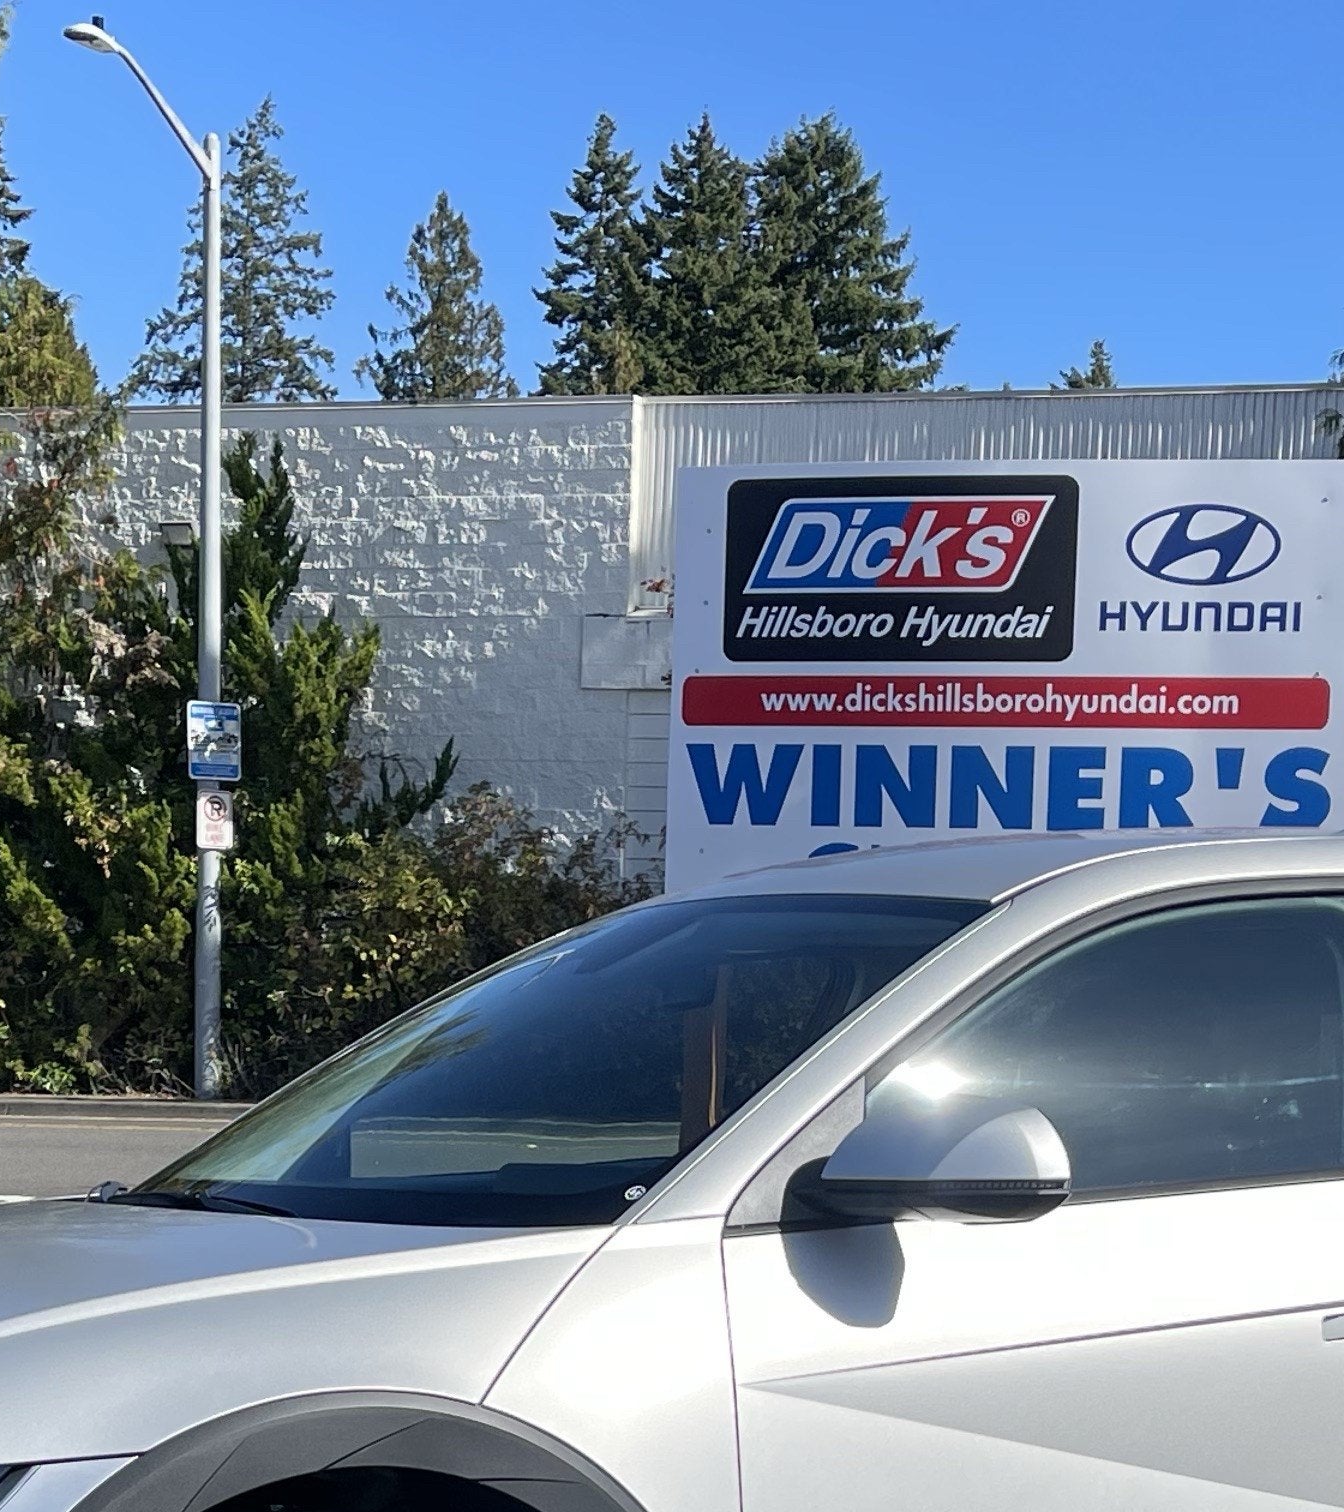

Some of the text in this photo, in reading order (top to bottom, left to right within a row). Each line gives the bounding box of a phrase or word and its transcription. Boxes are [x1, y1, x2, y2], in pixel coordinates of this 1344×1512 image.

[767, 507, 1014, 579] Dick's
[736, 606, 1055, 647] Hillsboro Hyundai
[1098, 601, 1302, 632] HYUNDAI
[760, 682, 1239, 721] www.dickshillsborohyundai.com
[686, 743, 1332, 830] WINNER'S
